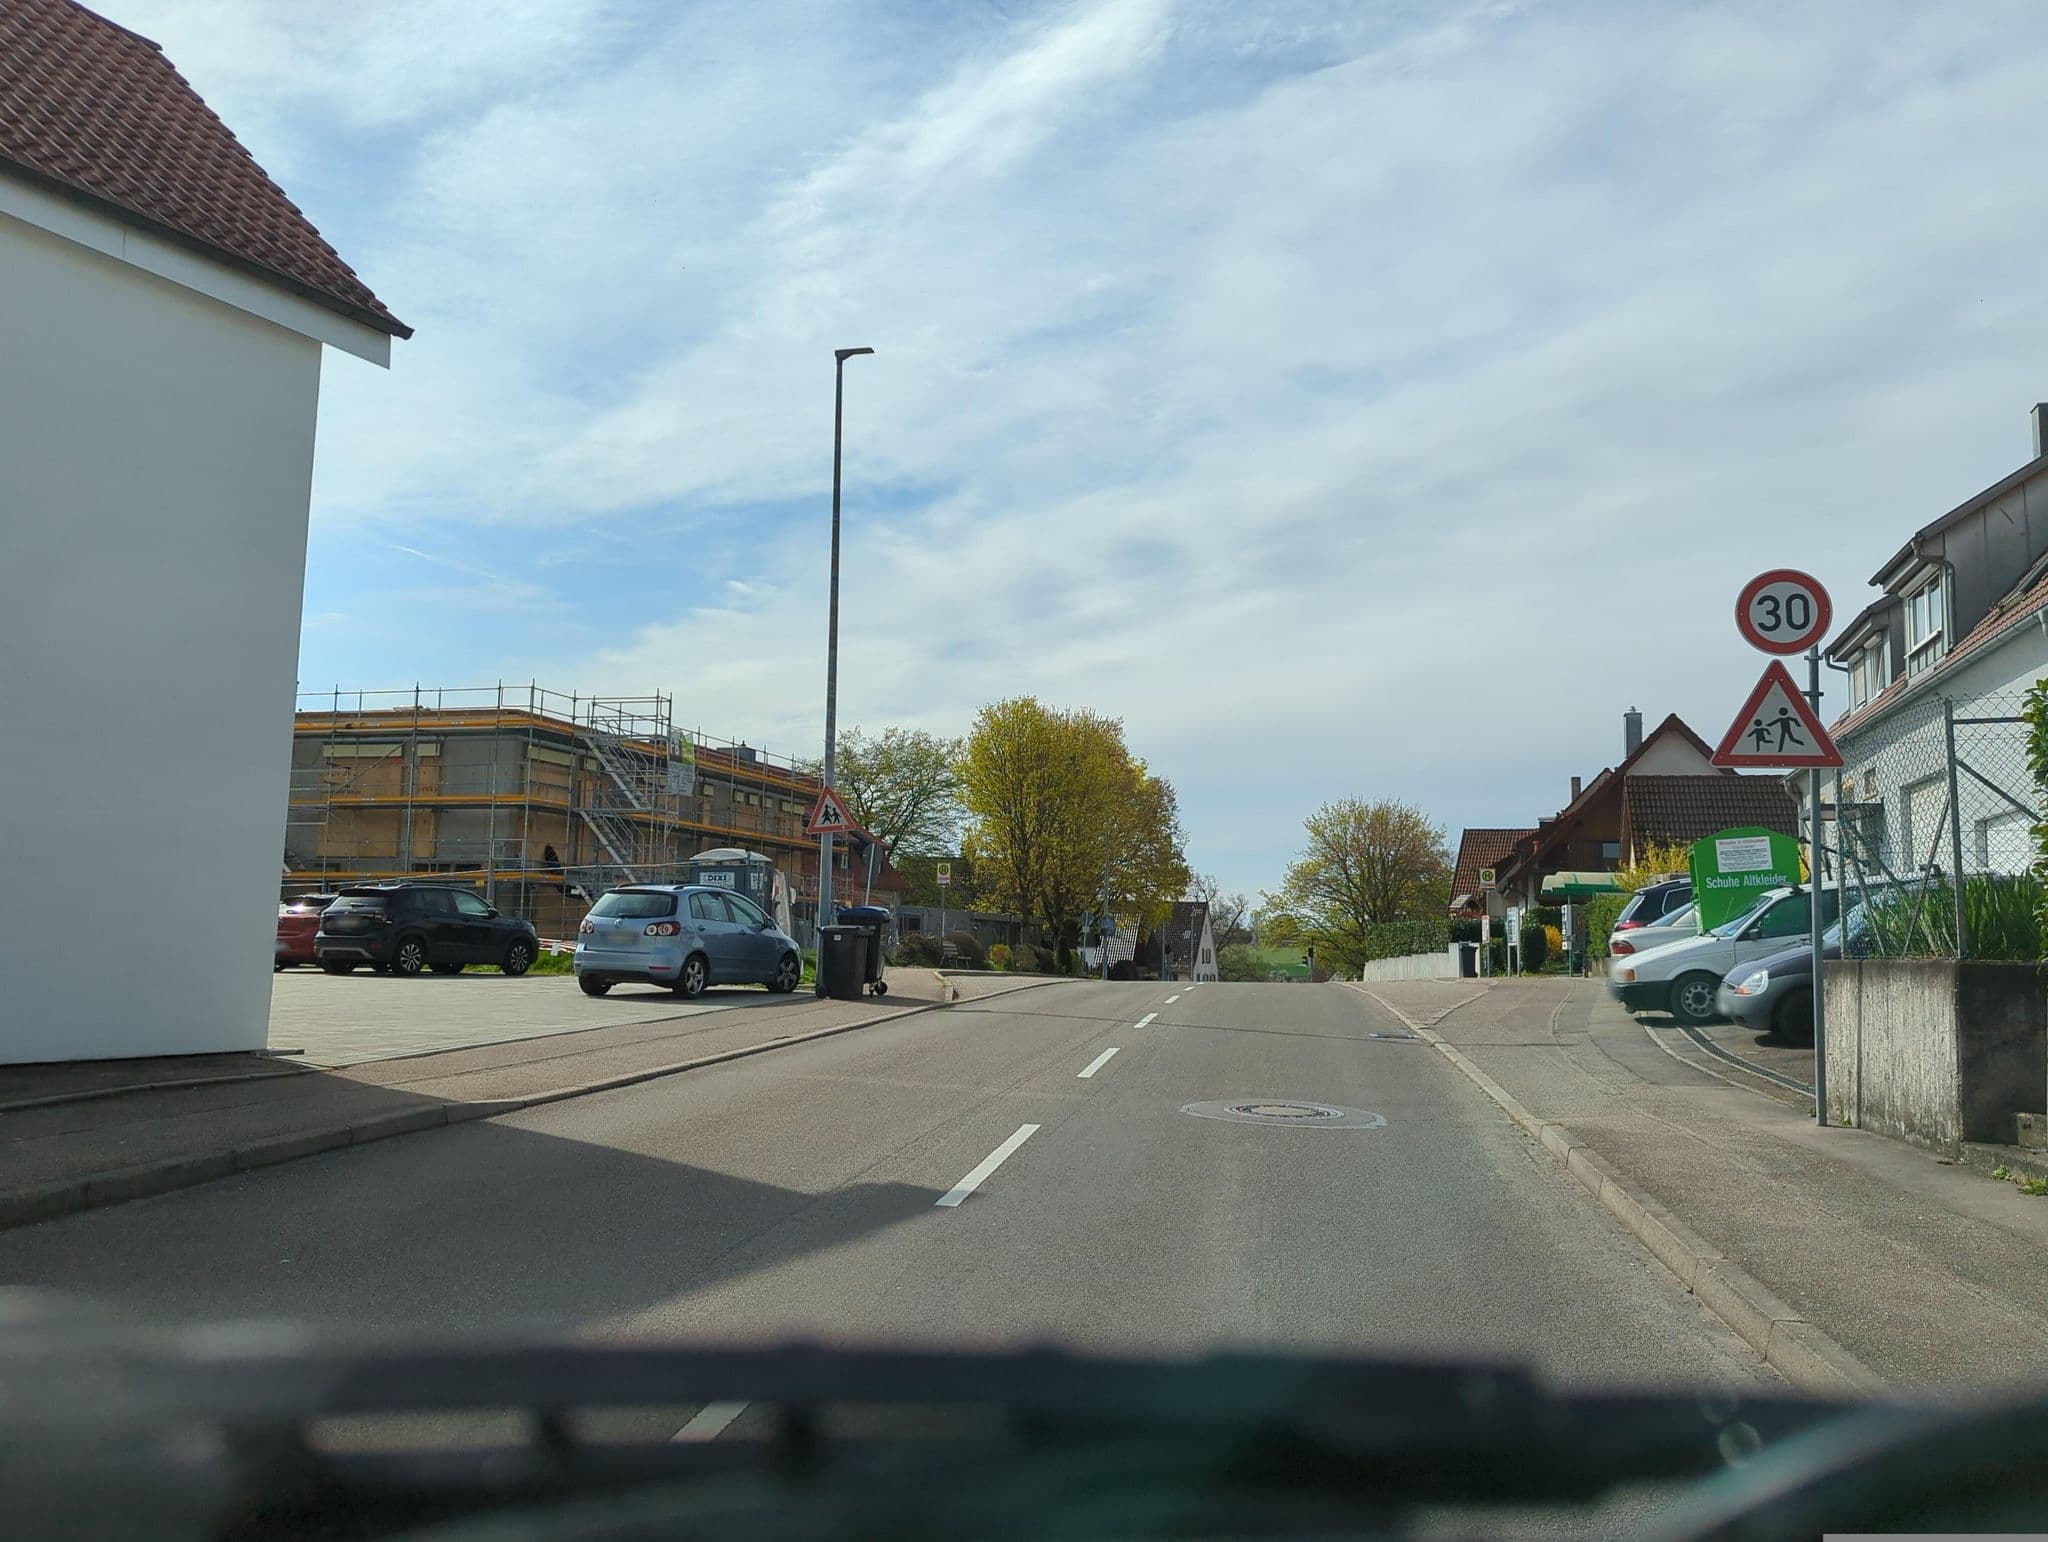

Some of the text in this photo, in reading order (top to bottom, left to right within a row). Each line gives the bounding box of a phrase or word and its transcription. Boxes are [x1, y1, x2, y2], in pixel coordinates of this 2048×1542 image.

[1757, 593, 1810, 632] 30
[1706, 873, 1787, 889] Schuhe Altkleider
